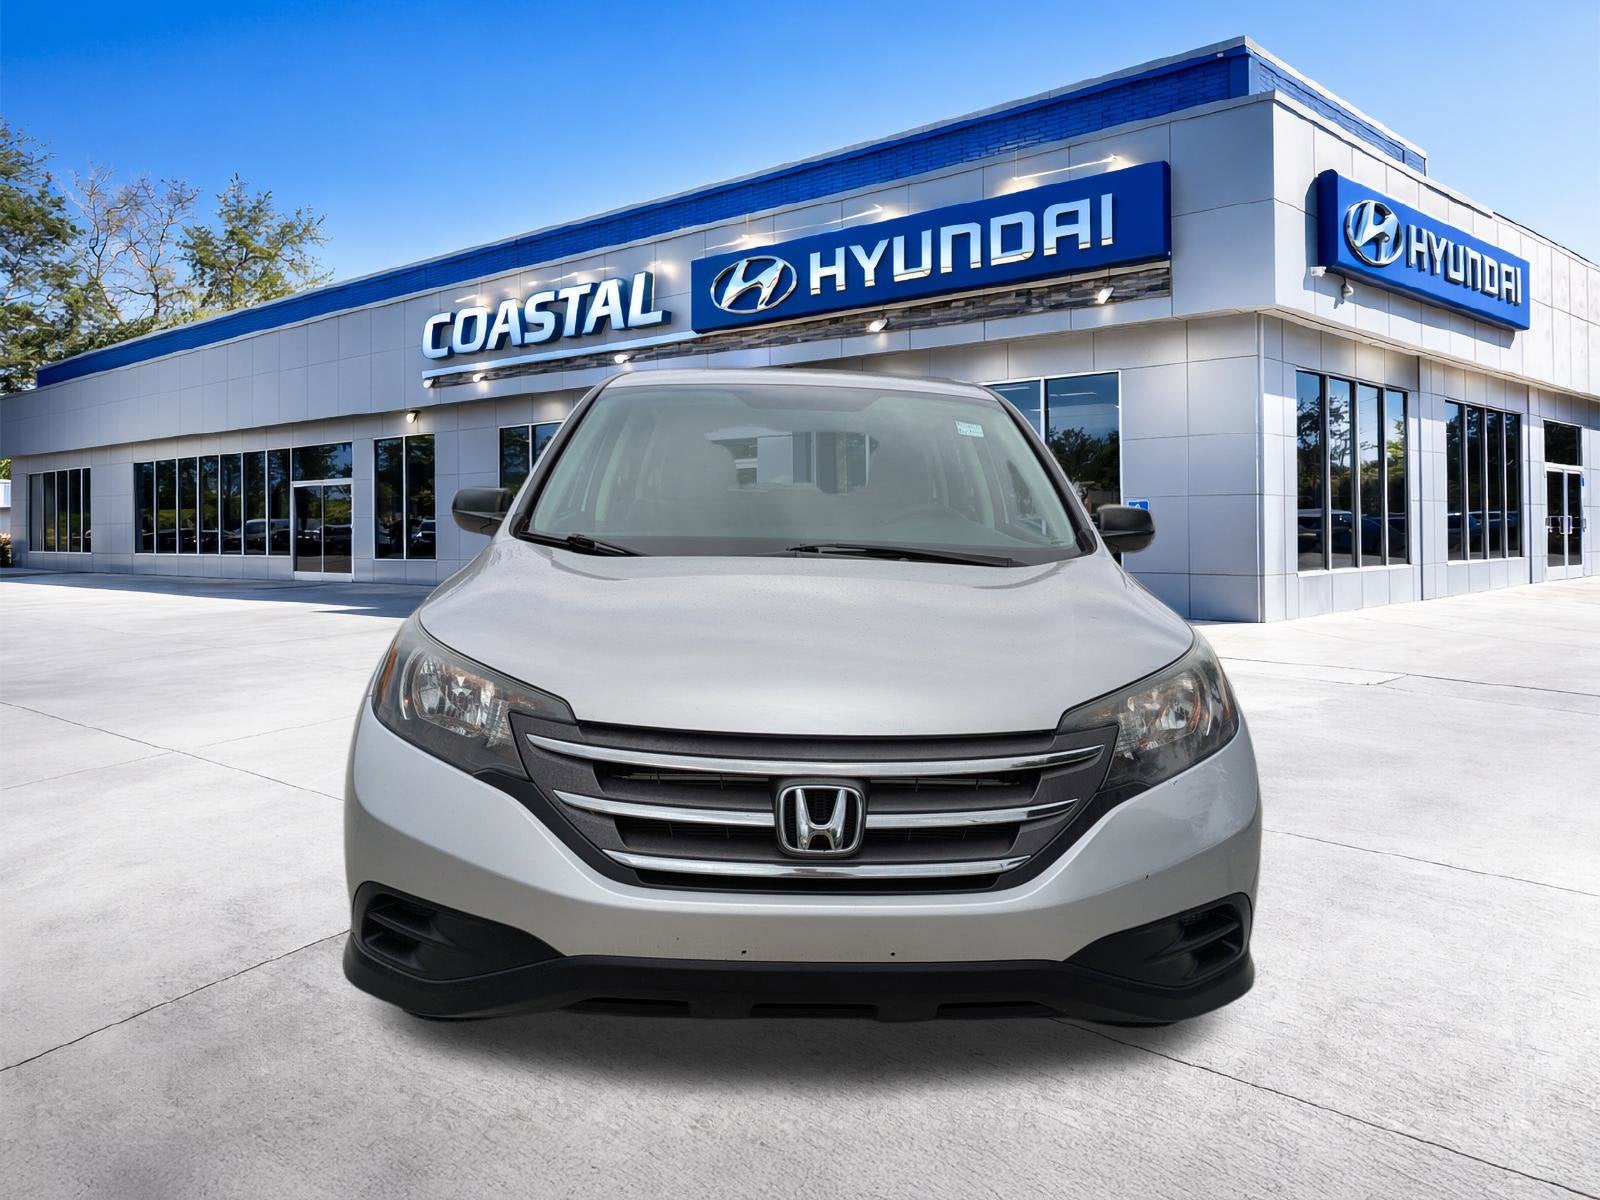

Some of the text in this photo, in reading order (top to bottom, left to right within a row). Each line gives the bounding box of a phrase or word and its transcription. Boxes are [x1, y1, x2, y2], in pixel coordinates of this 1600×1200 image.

[809, 192, 1114, 295] HYUNDAI
[1407, 224, 1522, 306] HYUNDAI
[422, 271, 669, 359] COASTAL
